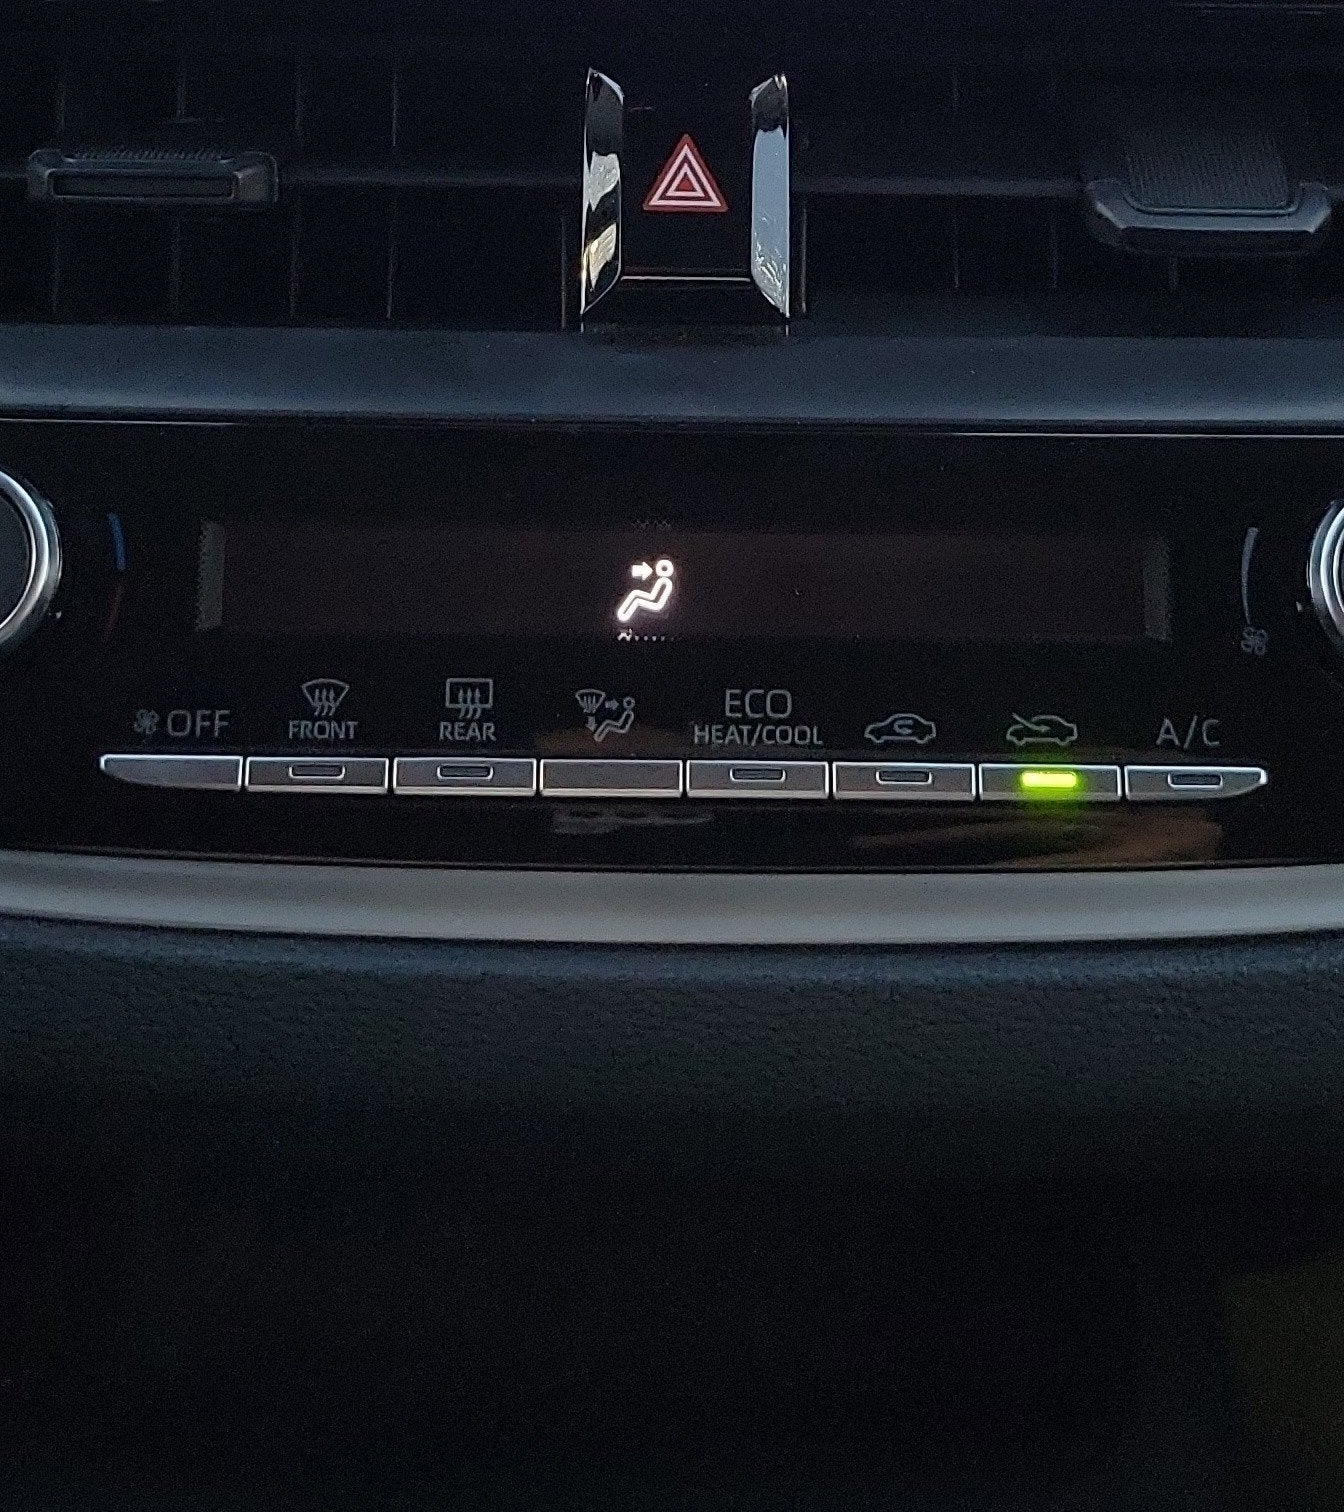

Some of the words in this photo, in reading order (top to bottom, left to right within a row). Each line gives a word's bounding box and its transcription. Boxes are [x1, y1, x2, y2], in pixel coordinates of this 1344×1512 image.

[723, 688, 792, 719] ECO
[166, 709, 231, 738] OFF
[288, 720, 358, 740] FRONT
[439, 720, 496, 741] REAR
[692, 723, 824, 747] HEAT/COOL
[1155, 717, 1221, 748] A/C
